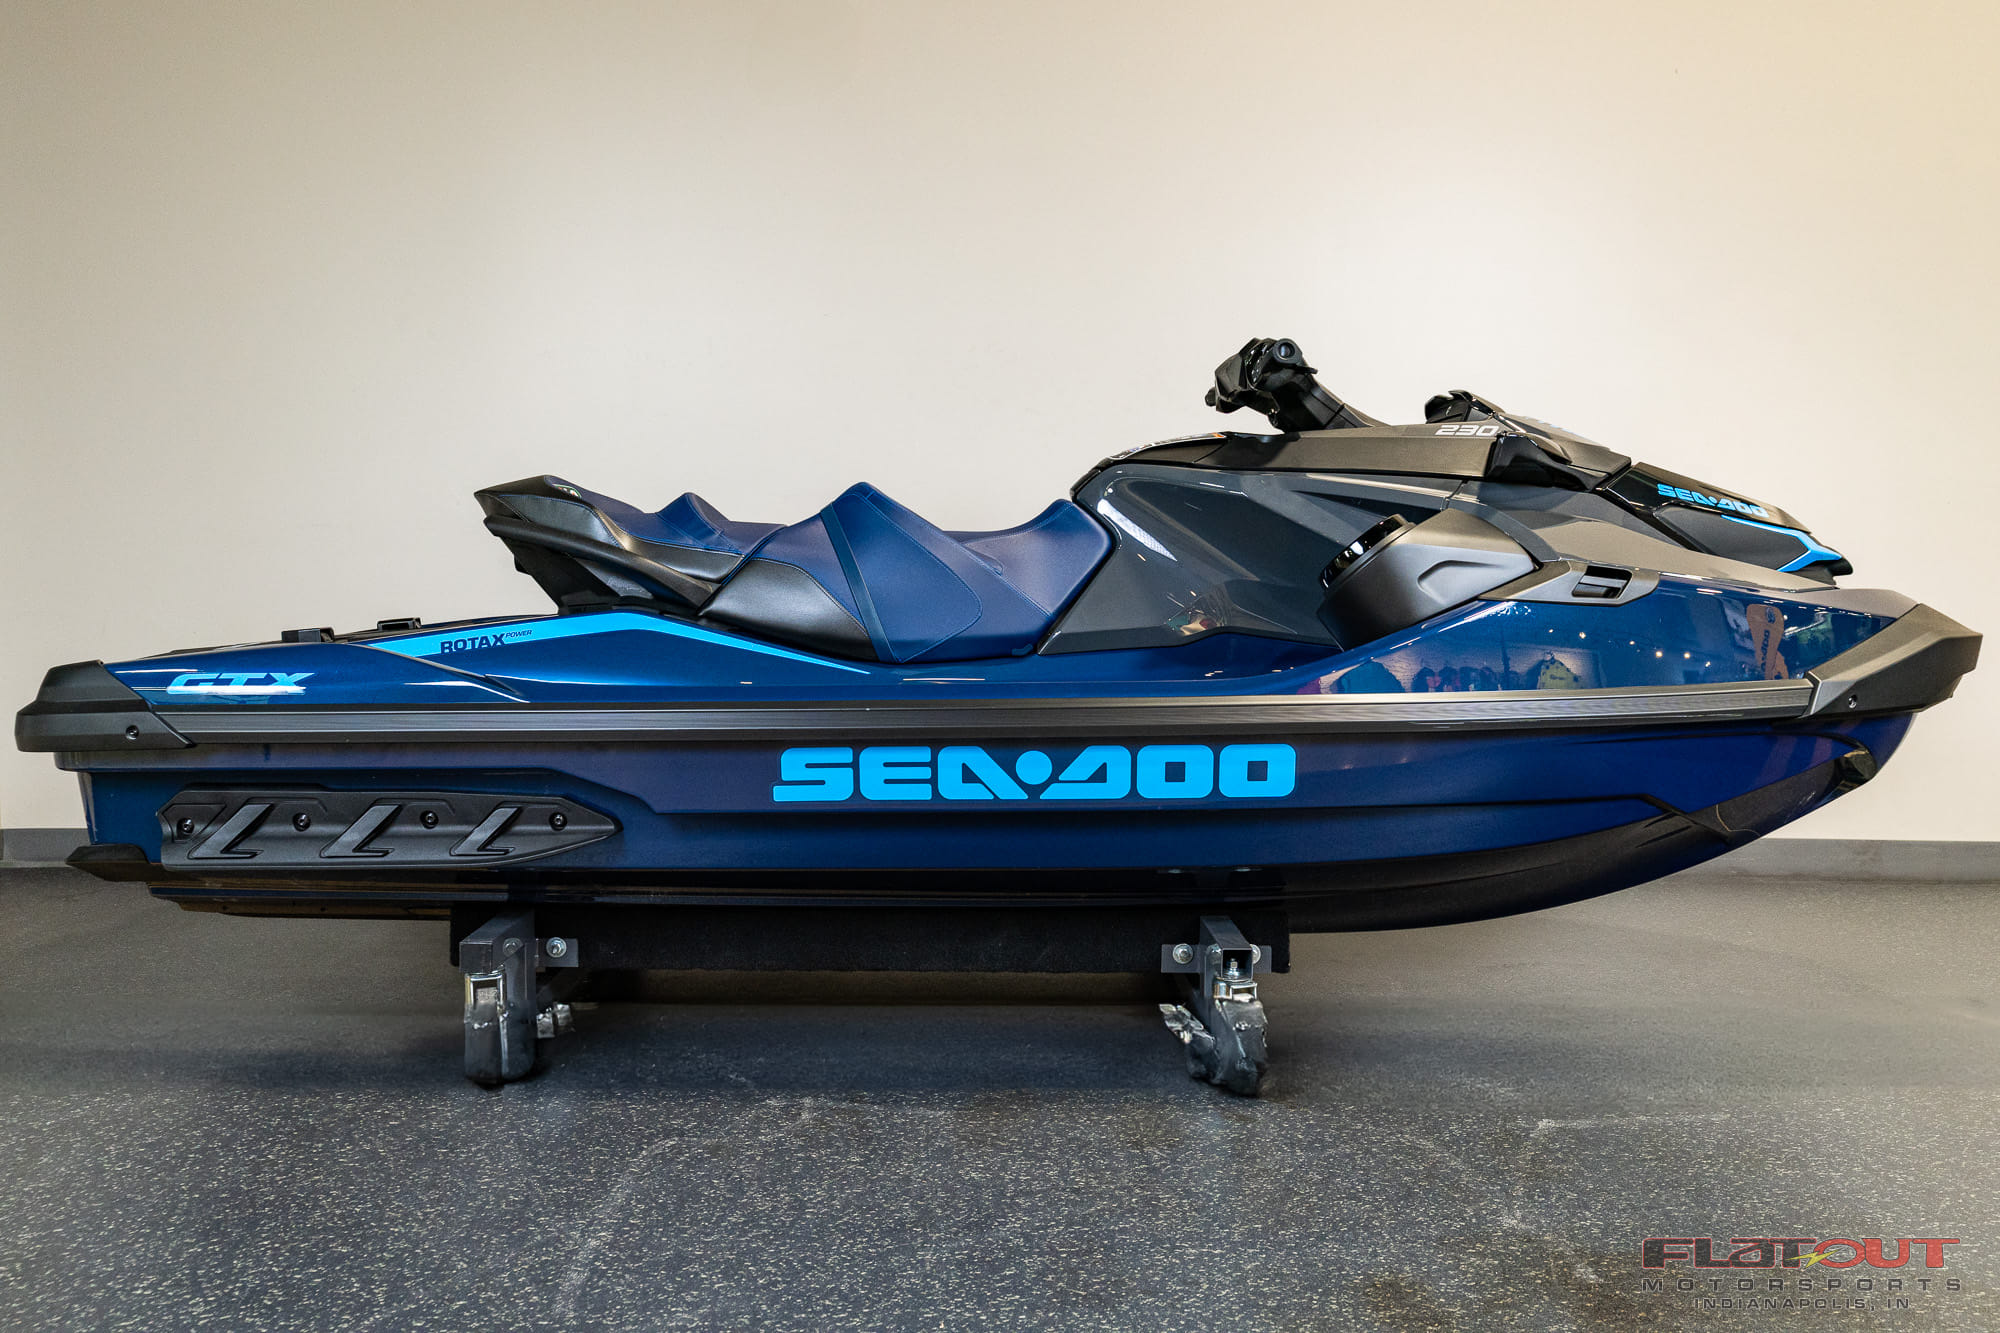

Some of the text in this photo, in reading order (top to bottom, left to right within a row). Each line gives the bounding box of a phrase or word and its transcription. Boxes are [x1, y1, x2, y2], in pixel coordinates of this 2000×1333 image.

[1435, 424, 1499, 436] 230
[440, 629, 533, 655] ROTAX POWER
[166, 672, 315, 696] GTX
